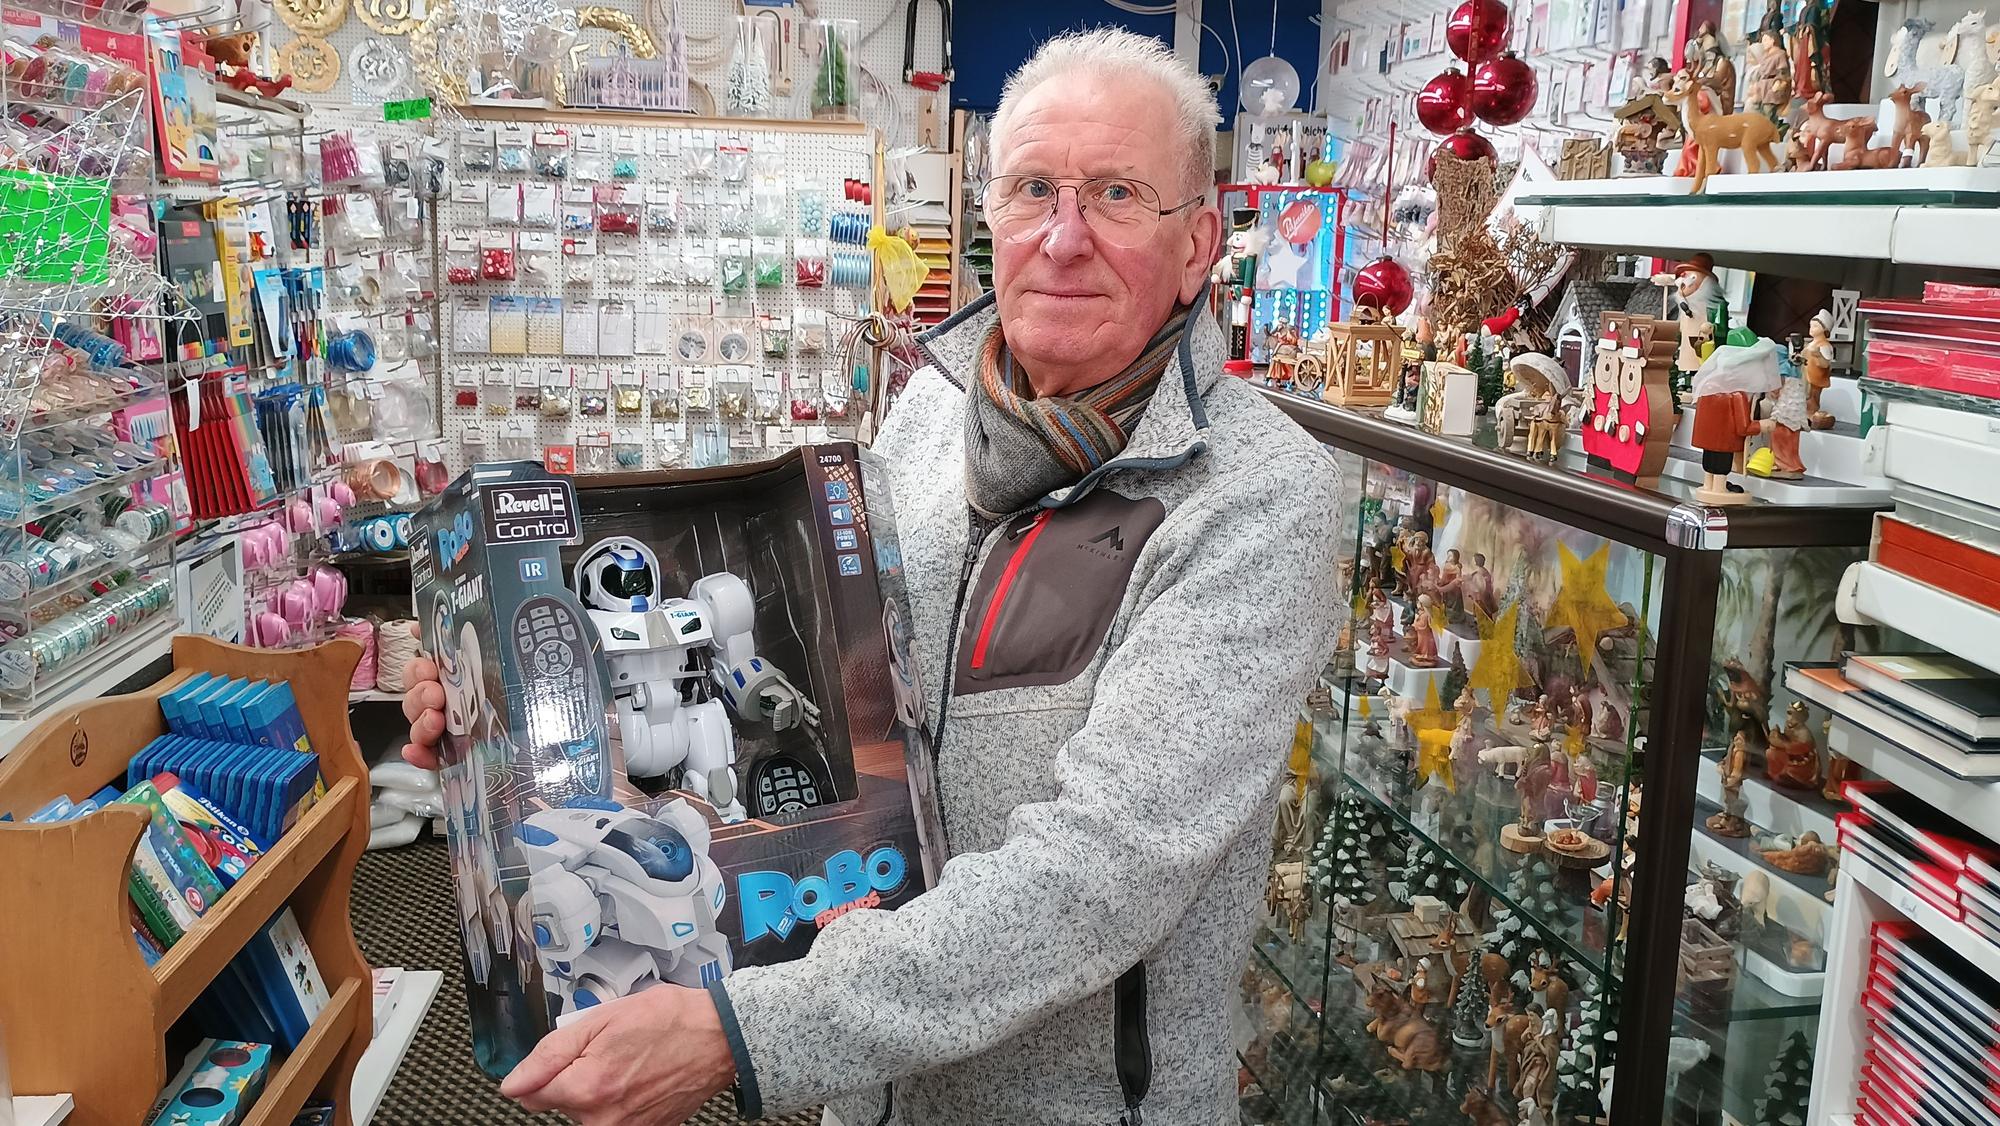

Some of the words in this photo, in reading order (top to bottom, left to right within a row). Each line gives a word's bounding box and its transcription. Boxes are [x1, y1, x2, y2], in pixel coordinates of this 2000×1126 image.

[819, 454, 842, 465] 24700
[496, 492, 550, 515] Revell
[495, 519, 569, 539] Control
[525, 562, 542, 577] IR
[451, 574, 484, 615] T-GIANT
[670, 610, 698, 619] T-GIANT
[197, 796, 238, 828] Pelikan
